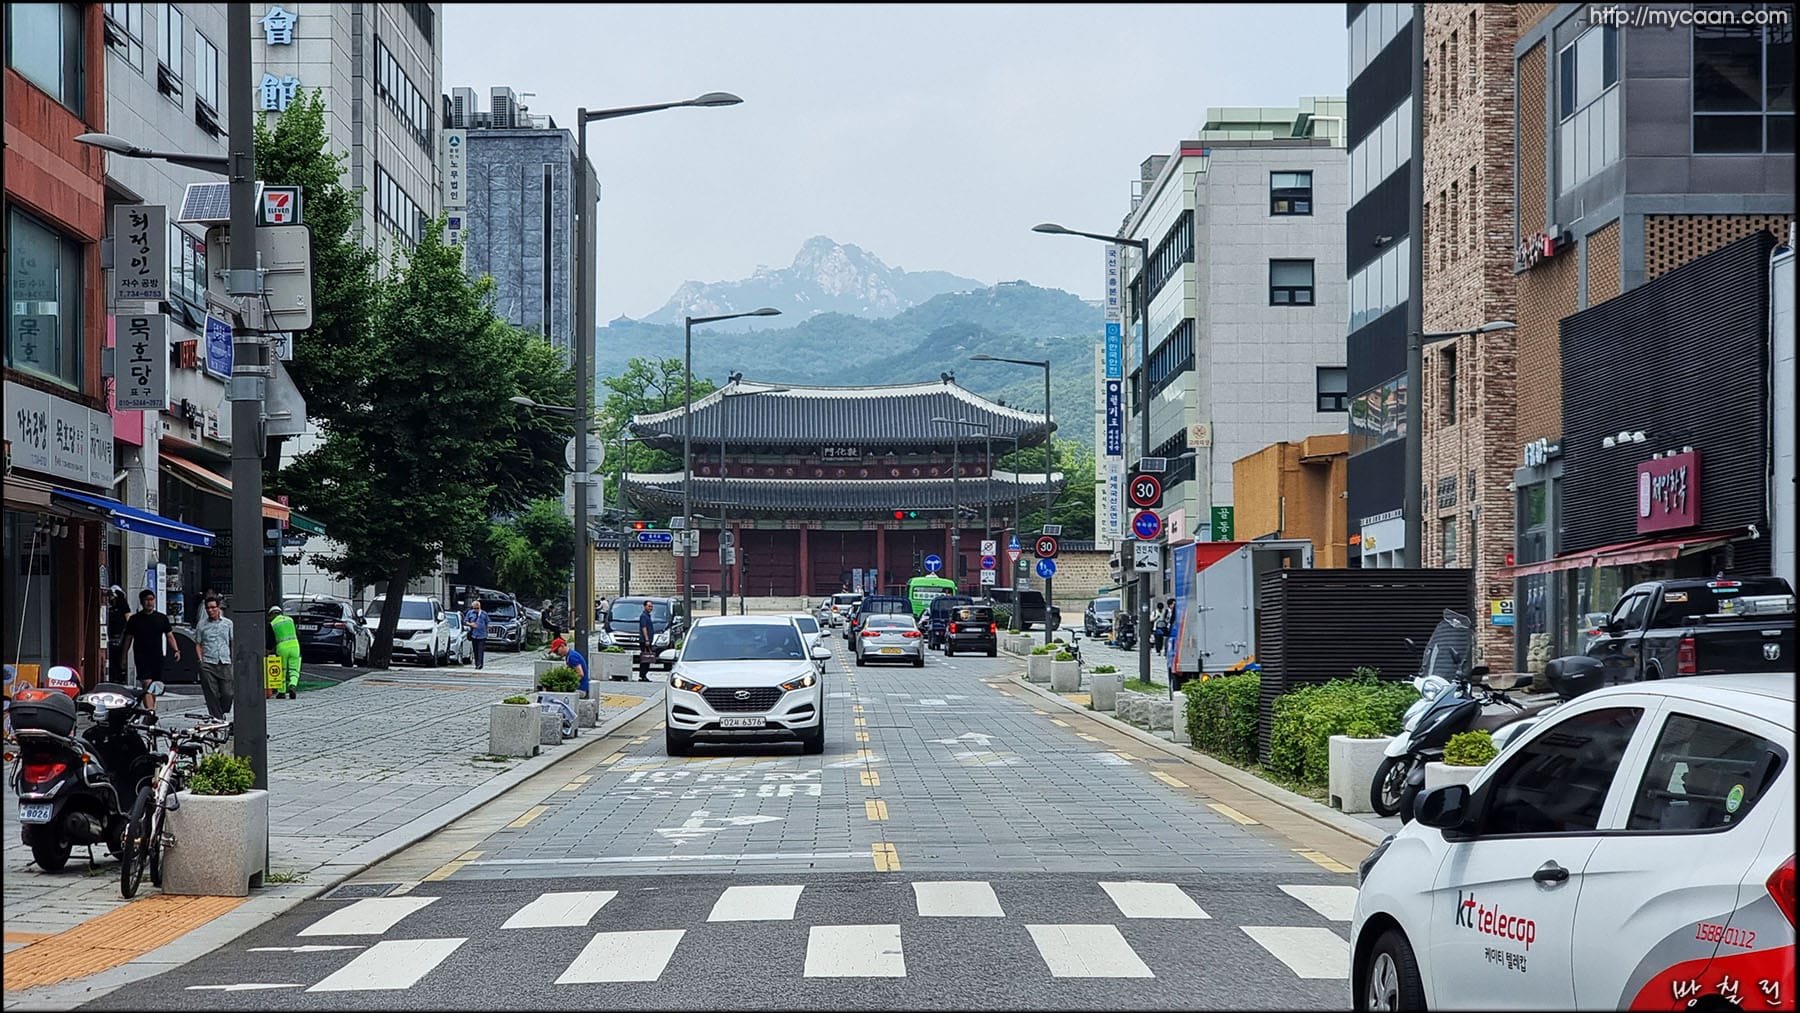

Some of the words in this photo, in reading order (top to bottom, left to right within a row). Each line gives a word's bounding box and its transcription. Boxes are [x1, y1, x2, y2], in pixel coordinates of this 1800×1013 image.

[129, 210, 149, 276] 최정인
[121, 279, 138, 288] 자수
[141, 279, 158, 288] 공방
[129, 318, 152, 386] 묵호당
[1136, 483, 1155, 498] 30
[1040, 541, 1053, 552] 30
[742, 718, 762, 727] 6376
[26, 809, 49, 819] 8026
[1456, 890, 1476, 928] kt
[1478, 904, 1536, 952] telecop
[1695, 923, 1756, 949] 1588-0112
[1485, 947, 1505, 966] 케이티
[1506, 952, 1527, 973] 텔레캅
